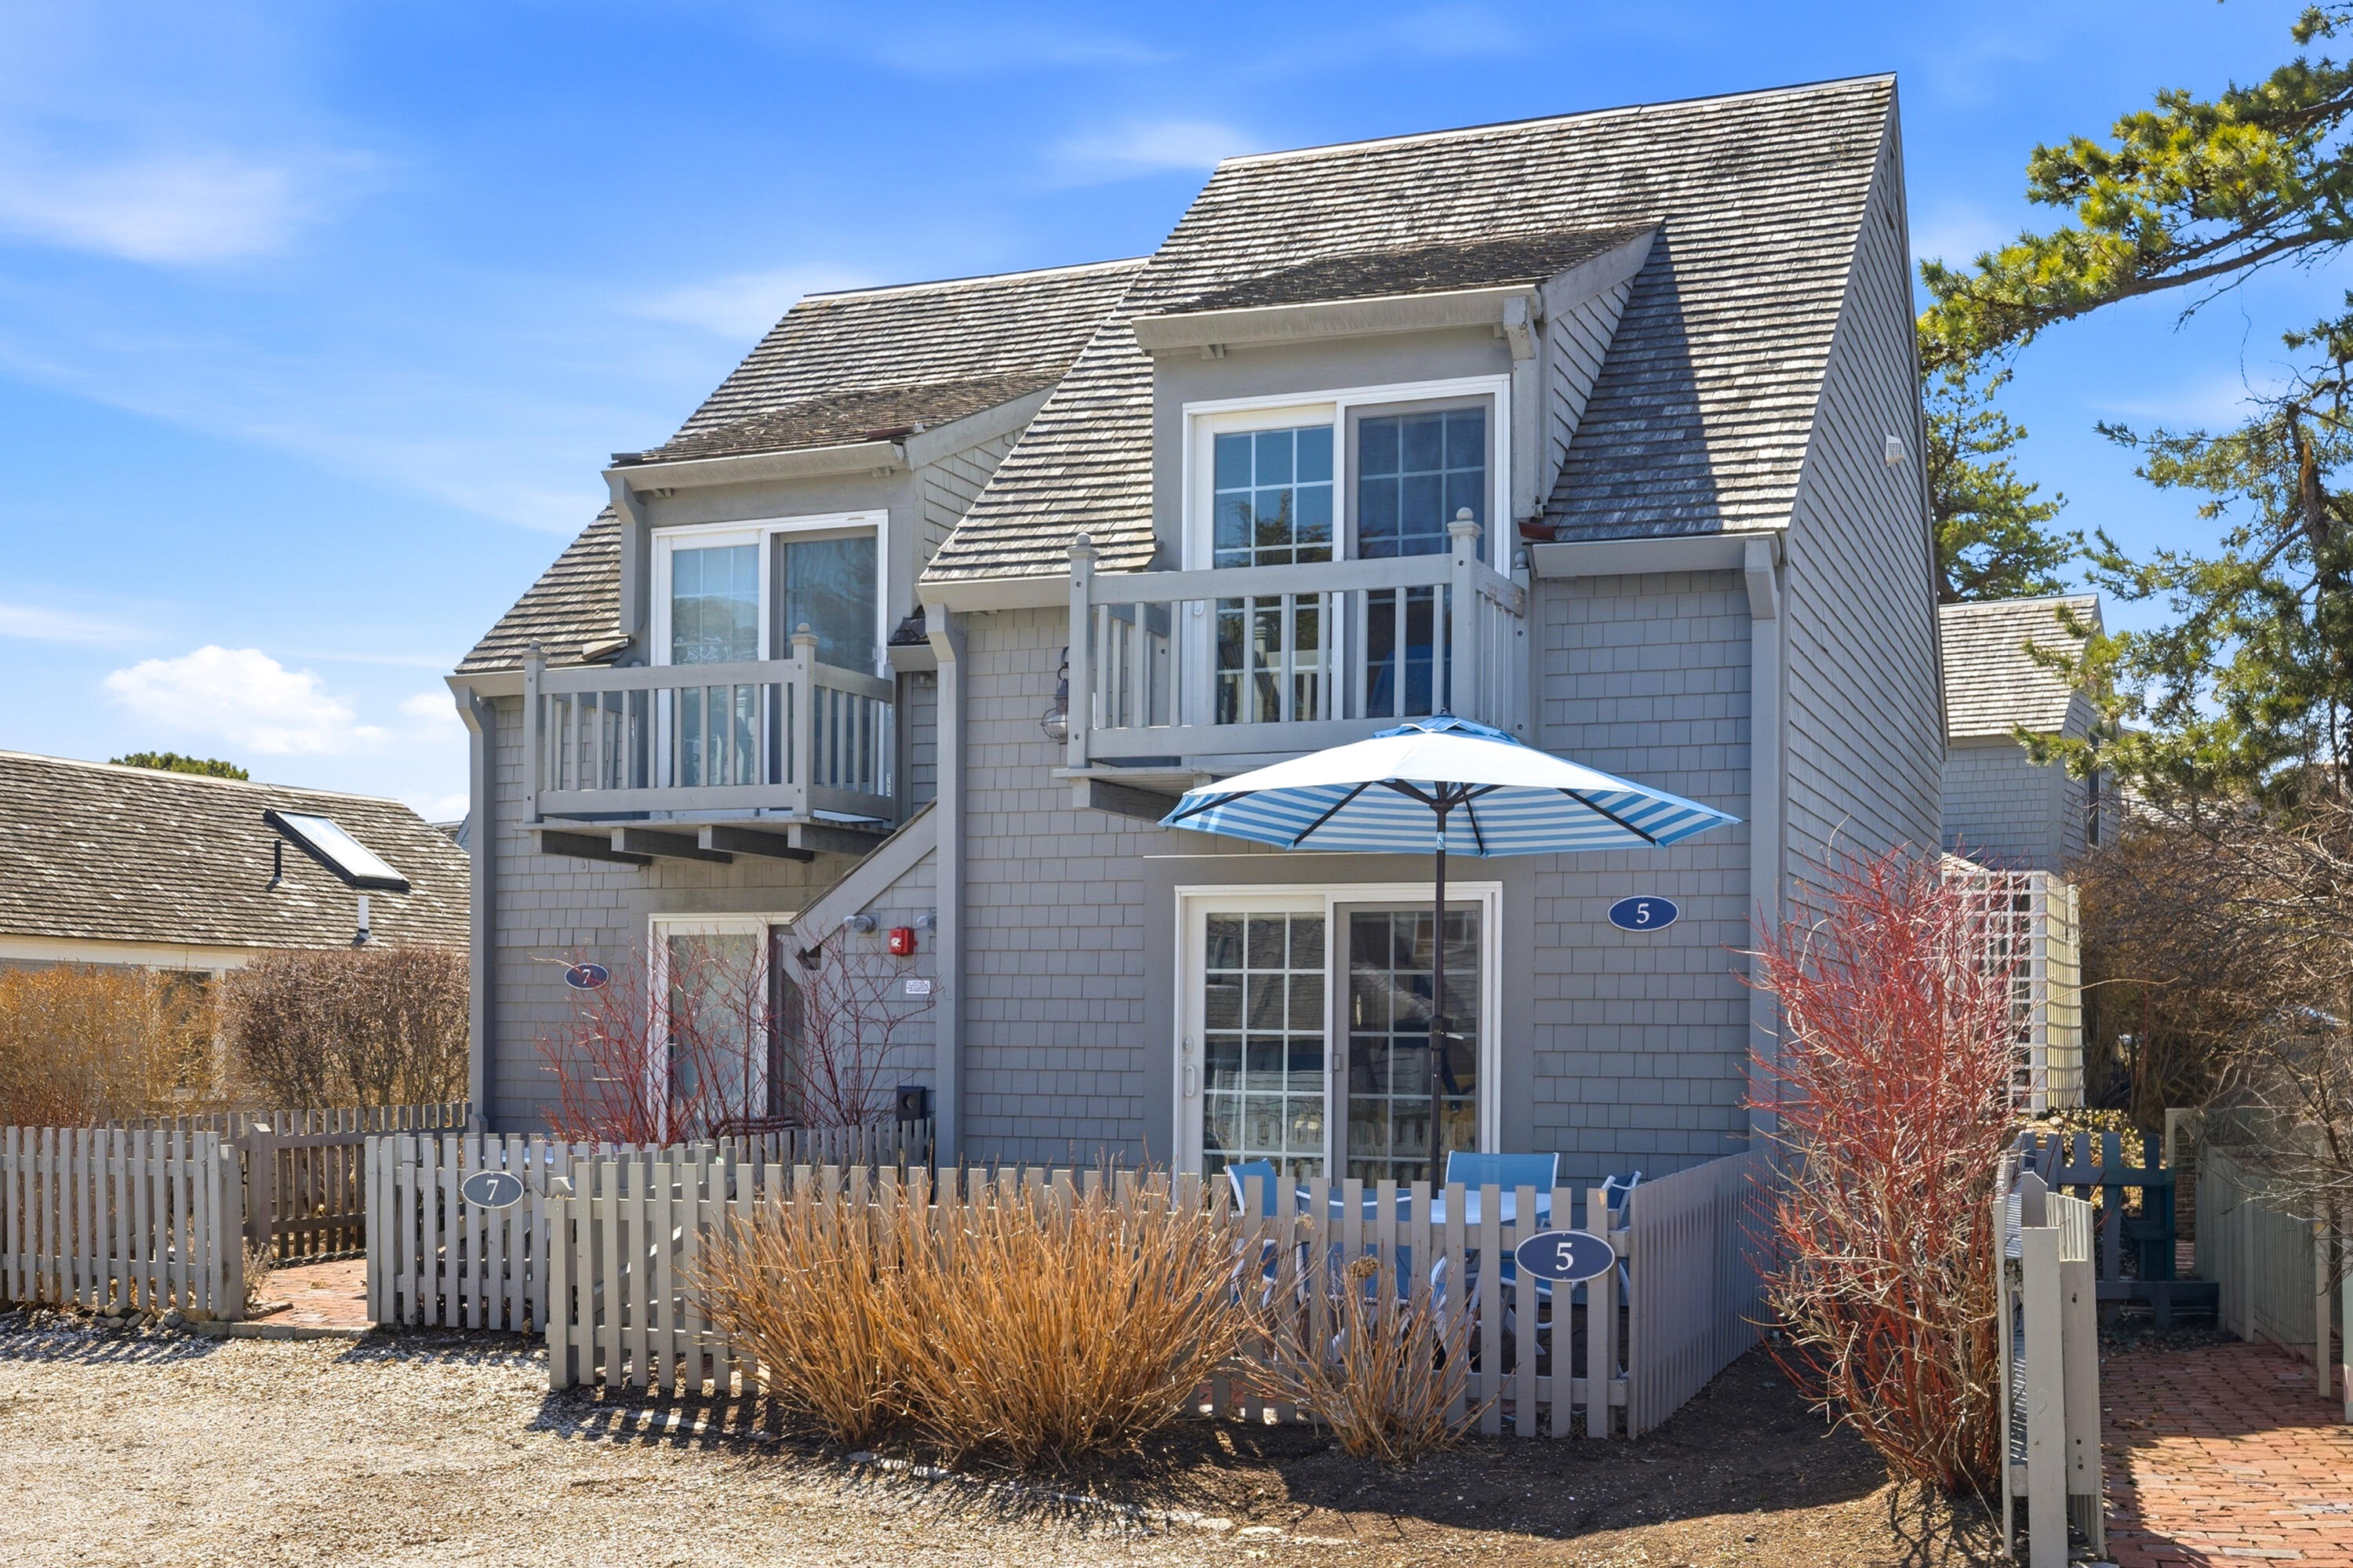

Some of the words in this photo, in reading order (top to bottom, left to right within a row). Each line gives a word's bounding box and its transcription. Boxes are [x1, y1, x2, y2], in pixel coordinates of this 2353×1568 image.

[1636, 903, 1649, 924] 5
[583, 969, 591, 984] 7
[486, 1179, 499, 1200] 7
[1555, 1242, 1573, 1271] 5
